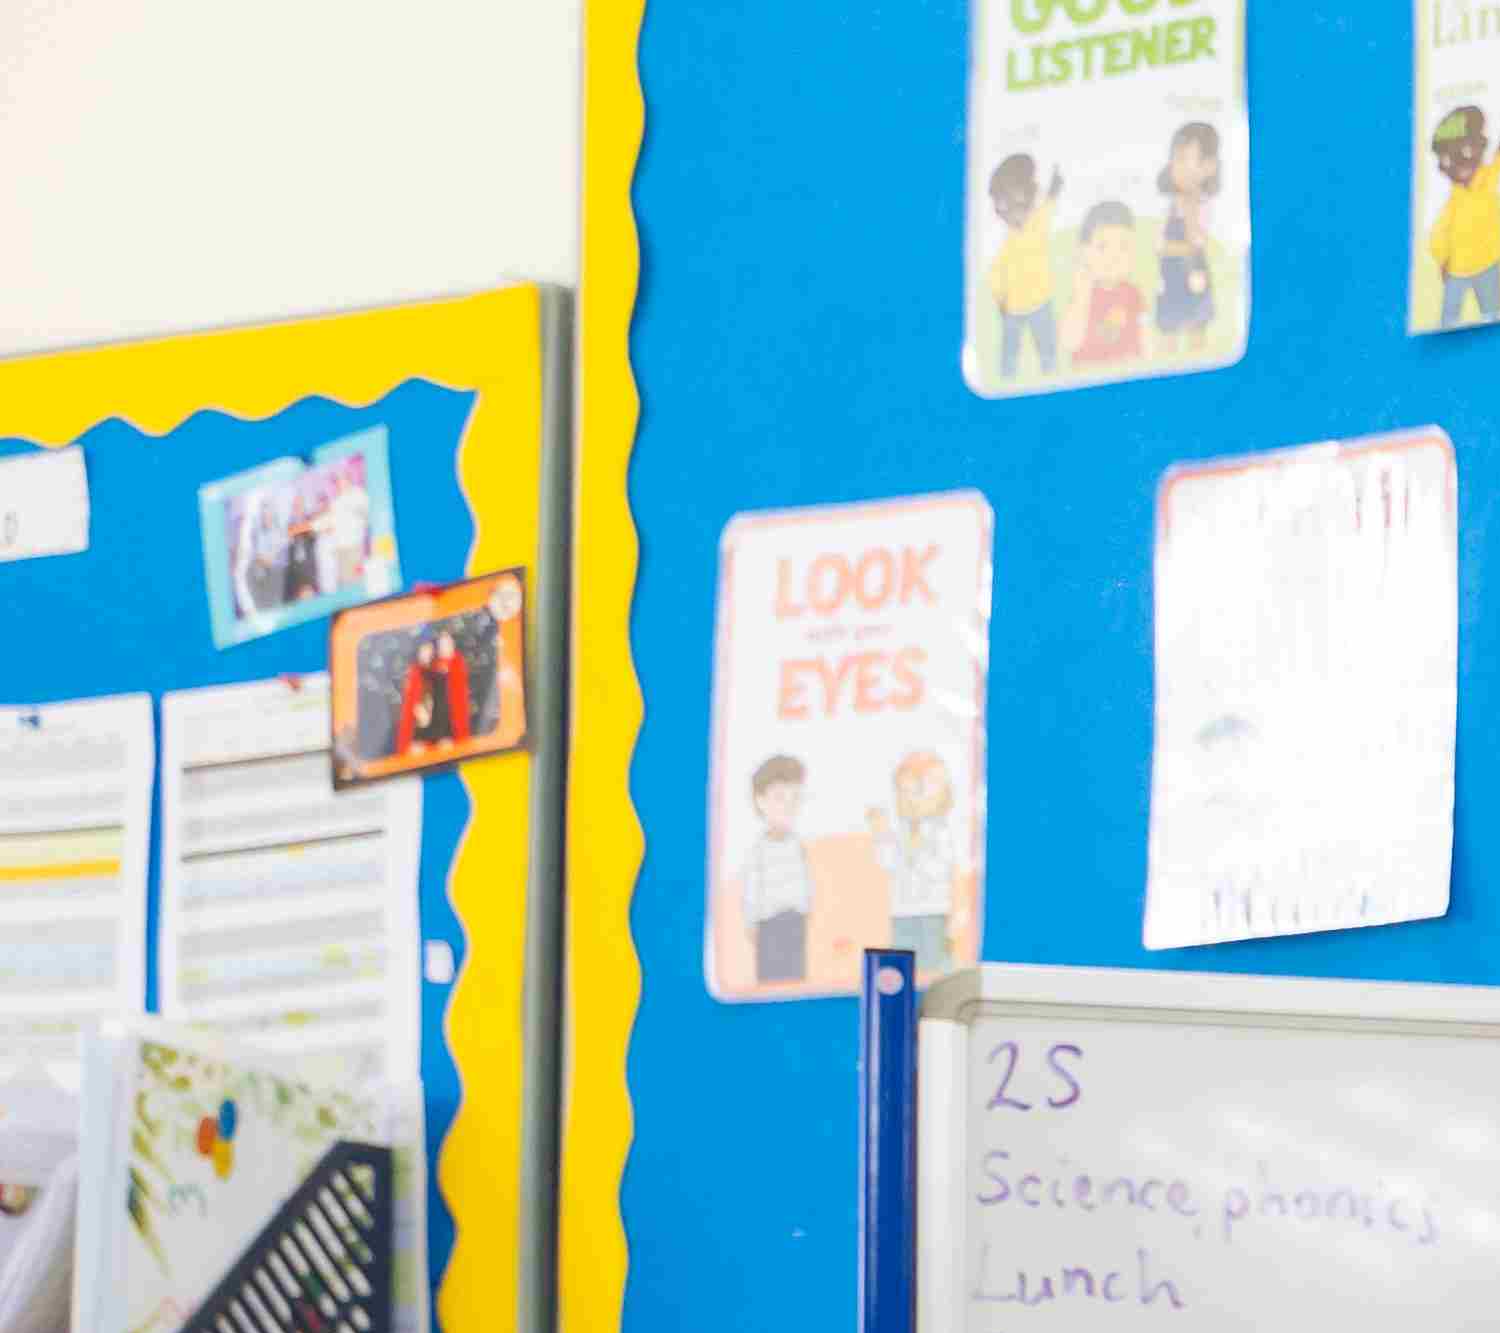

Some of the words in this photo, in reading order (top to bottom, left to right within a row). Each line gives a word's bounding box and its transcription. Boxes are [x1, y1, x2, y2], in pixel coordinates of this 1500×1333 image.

[1005, 15, 1216, 92] LISTENER
[773, 545, 942, 622] LOOK
[775, 645, 929, 721] EYES
[985, 1040, 1084, 1112] 2S
[971, 1242, 1184, 1309] Lunch
